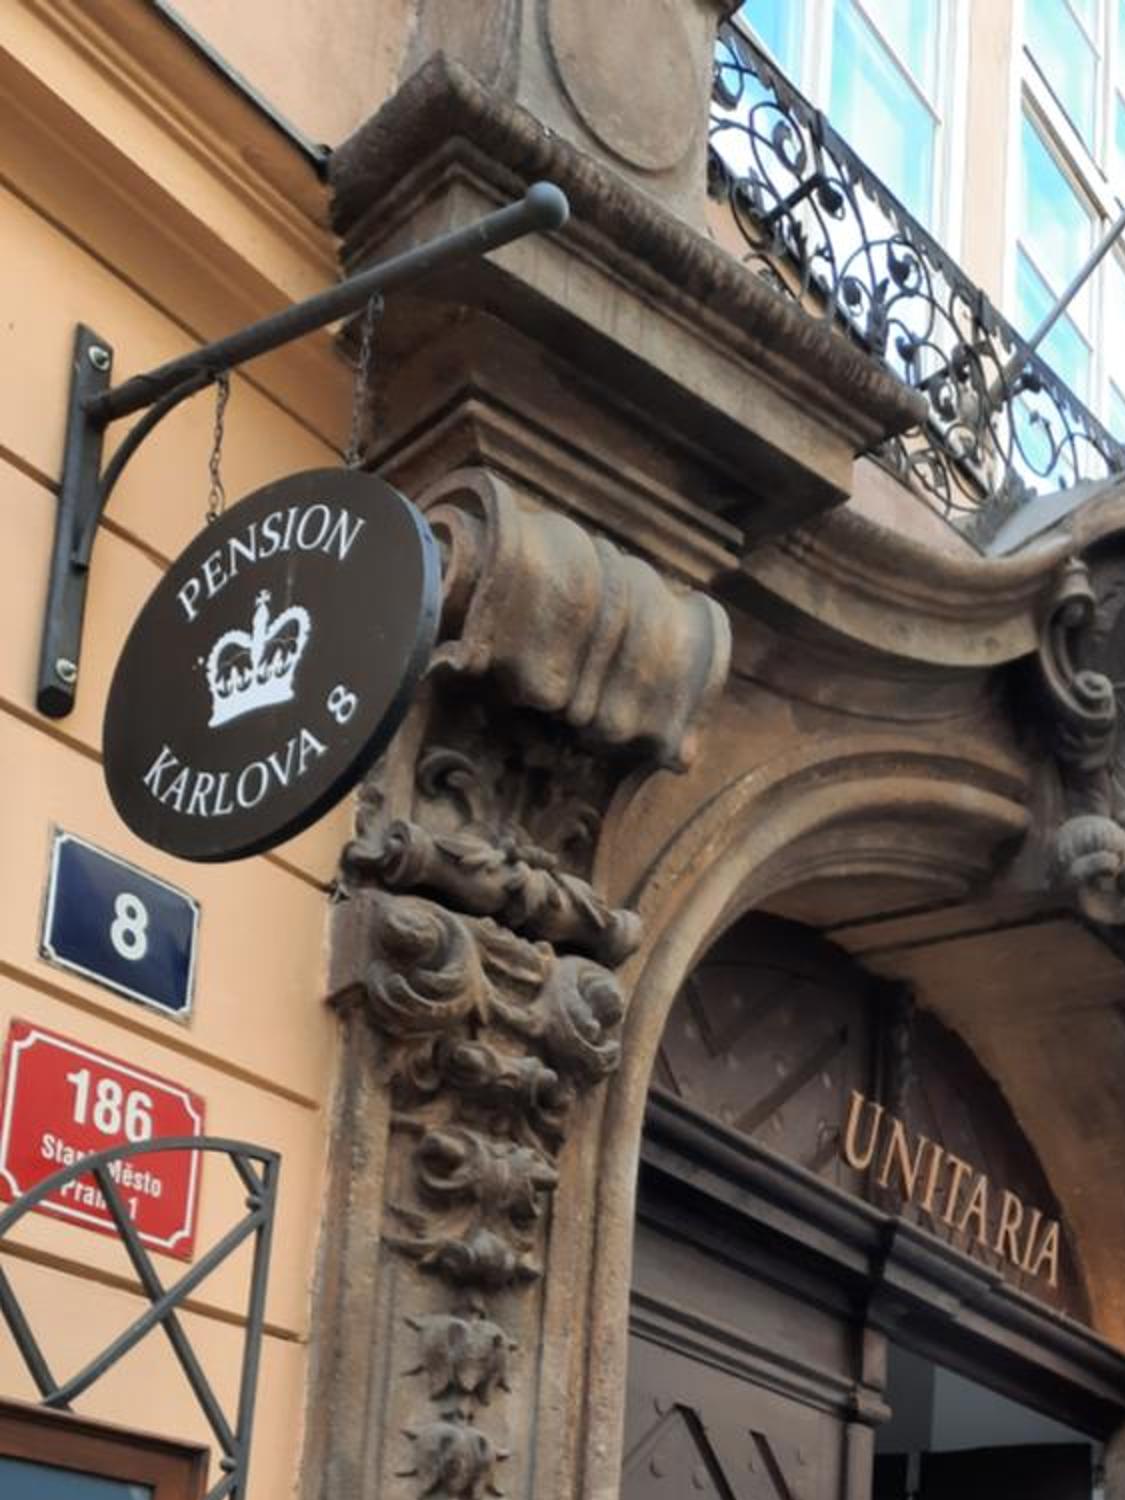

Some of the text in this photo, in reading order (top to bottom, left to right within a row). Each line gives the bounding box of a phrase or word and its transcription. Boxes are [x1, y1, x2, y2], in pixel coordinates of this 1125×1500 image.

[177, 503, 365, 621] PENSION
[143, 684, 358, 817] KARLOVA 8
[109, 892, 150, 962] 8
[66, 1067, 154, 1143] 186
[128, 1196, 138, 1221] 1
[845, 1089, 1060, 1288] UNITARIA
